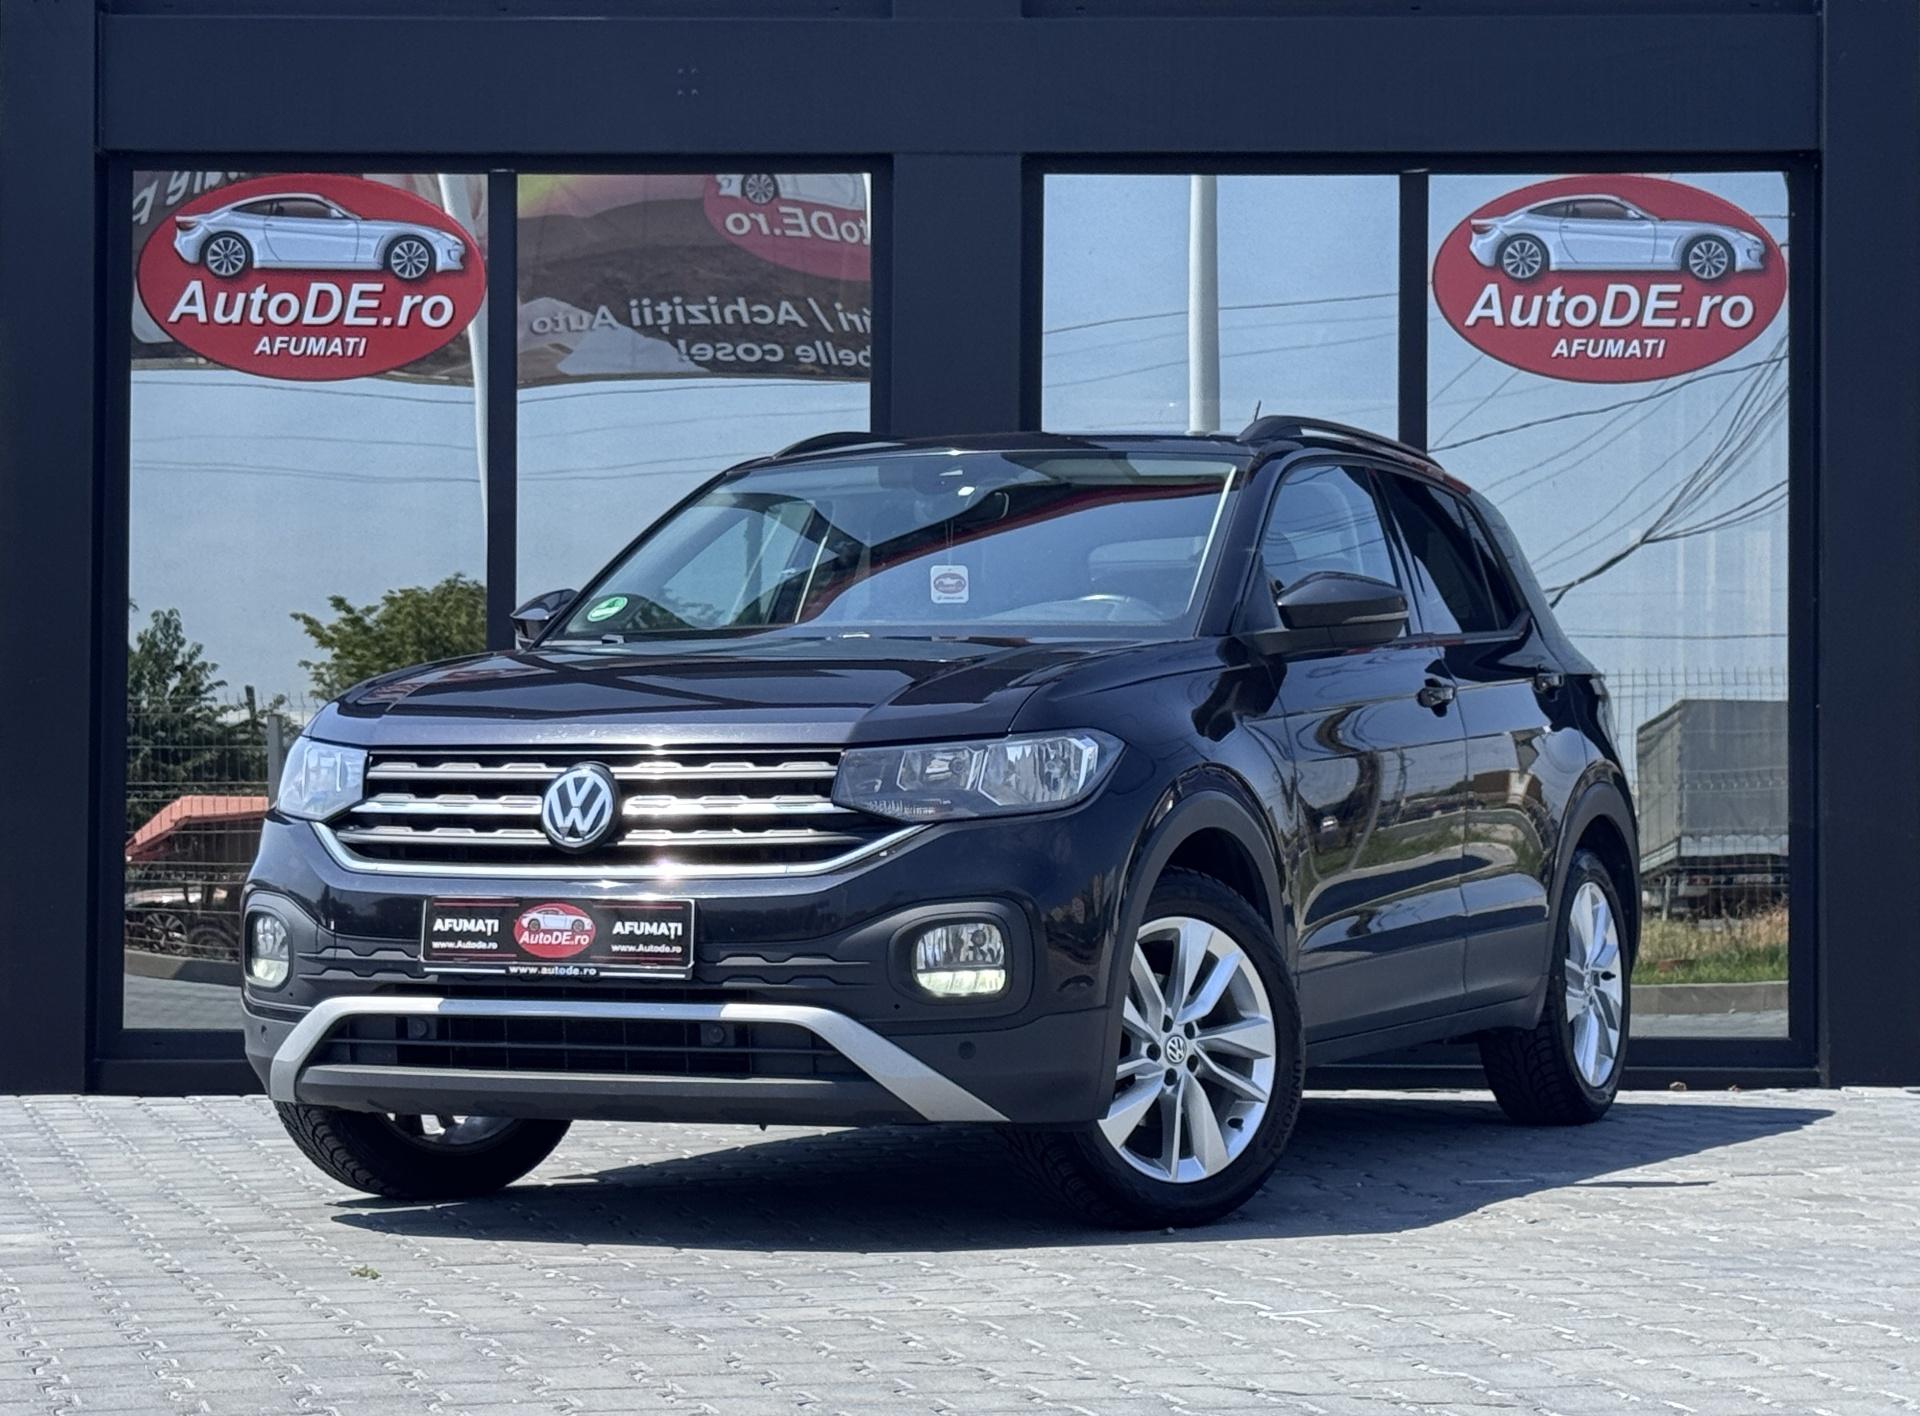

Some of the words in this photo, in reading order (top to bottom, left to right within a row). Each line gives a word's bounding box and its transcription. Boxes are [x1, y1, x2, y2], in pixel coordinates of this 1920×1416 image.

[167, 281, 454, 328] AutoDE.ro
[1464, 283, 1754, 328] AutoDE.ro
[253, 337, 367, 358] AFUMATI
[1551, 339, 1666, 358] AFUMATI
[546, 771, 610, 840] VW
[519, 931, 590, 945] AutoDE.ro
[508, 965, 597, 976] www.autode.ro
